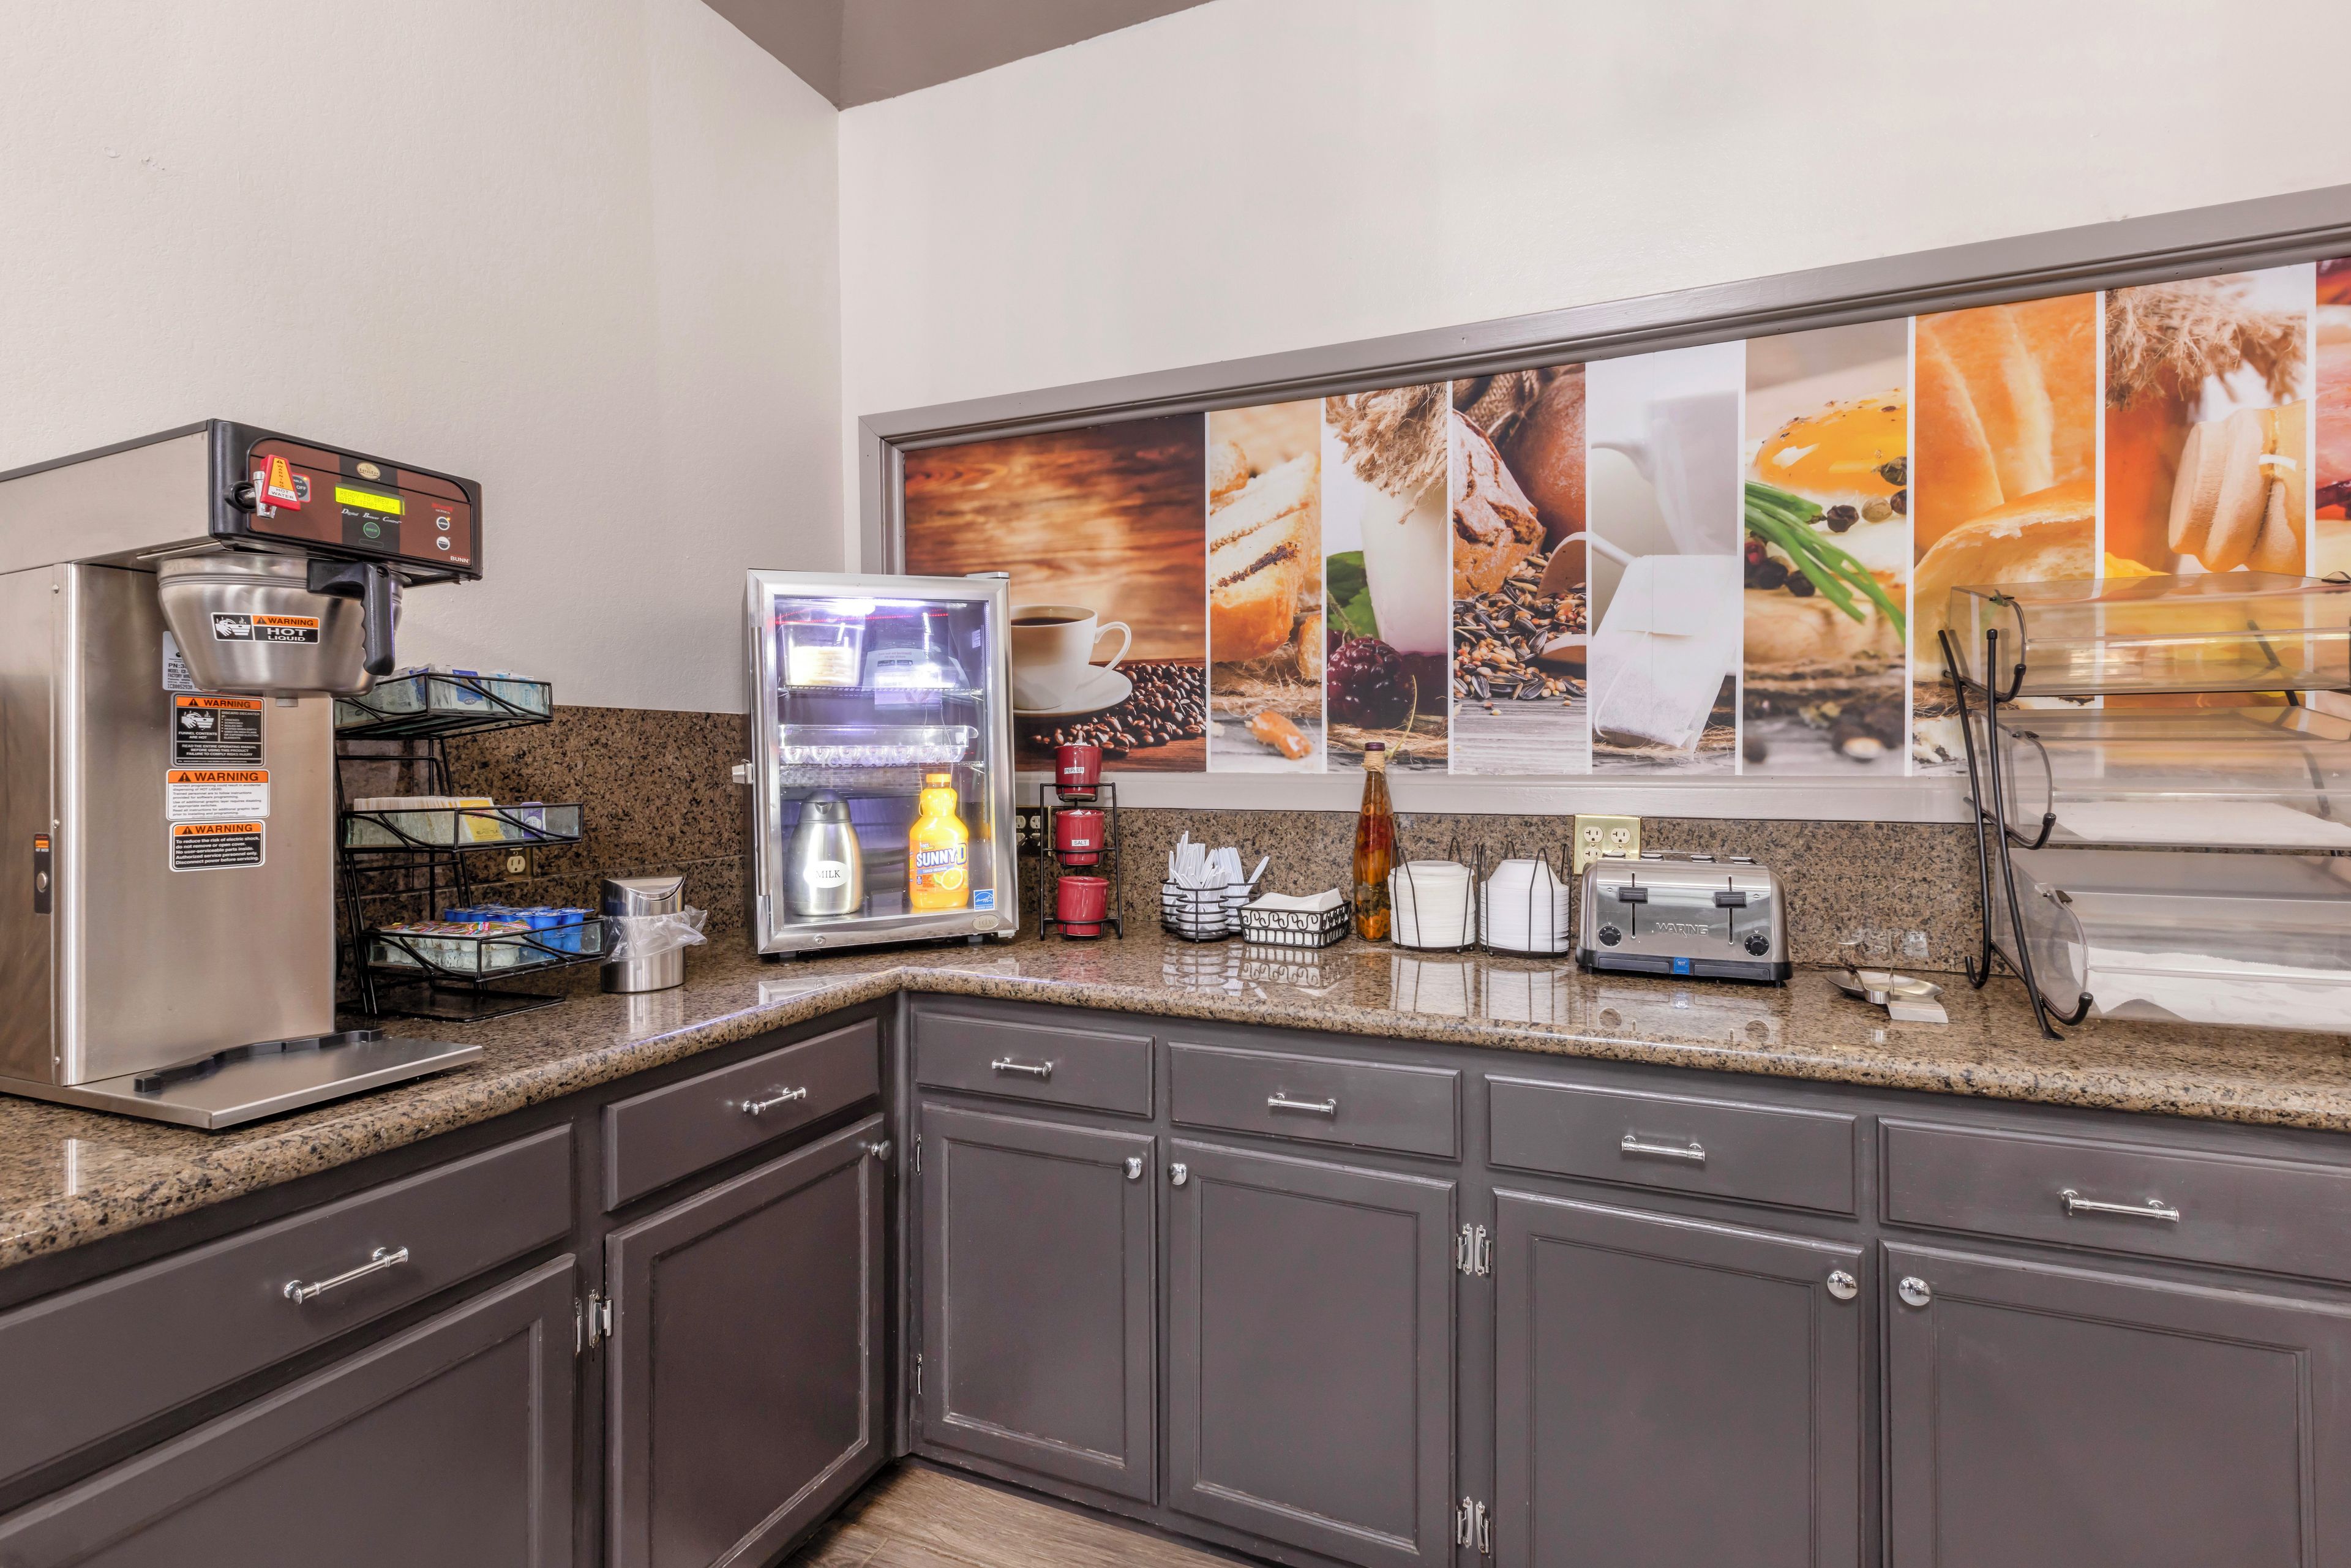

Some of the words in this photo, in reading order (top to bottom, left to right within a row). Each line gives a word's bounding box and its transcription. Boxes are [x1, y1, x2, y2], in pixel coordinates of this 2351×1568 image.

[272, 491, 294, 500] WATER
[340, 490, 359, 498] READY
[267, 628, 307, 636] HOT
[204, 699, 250, 708] WARNING
[194, 773, 258, 781] WARNING
[195, 824, 253, 833] WARNING
[1656, 923, 1708, 938] WARING
